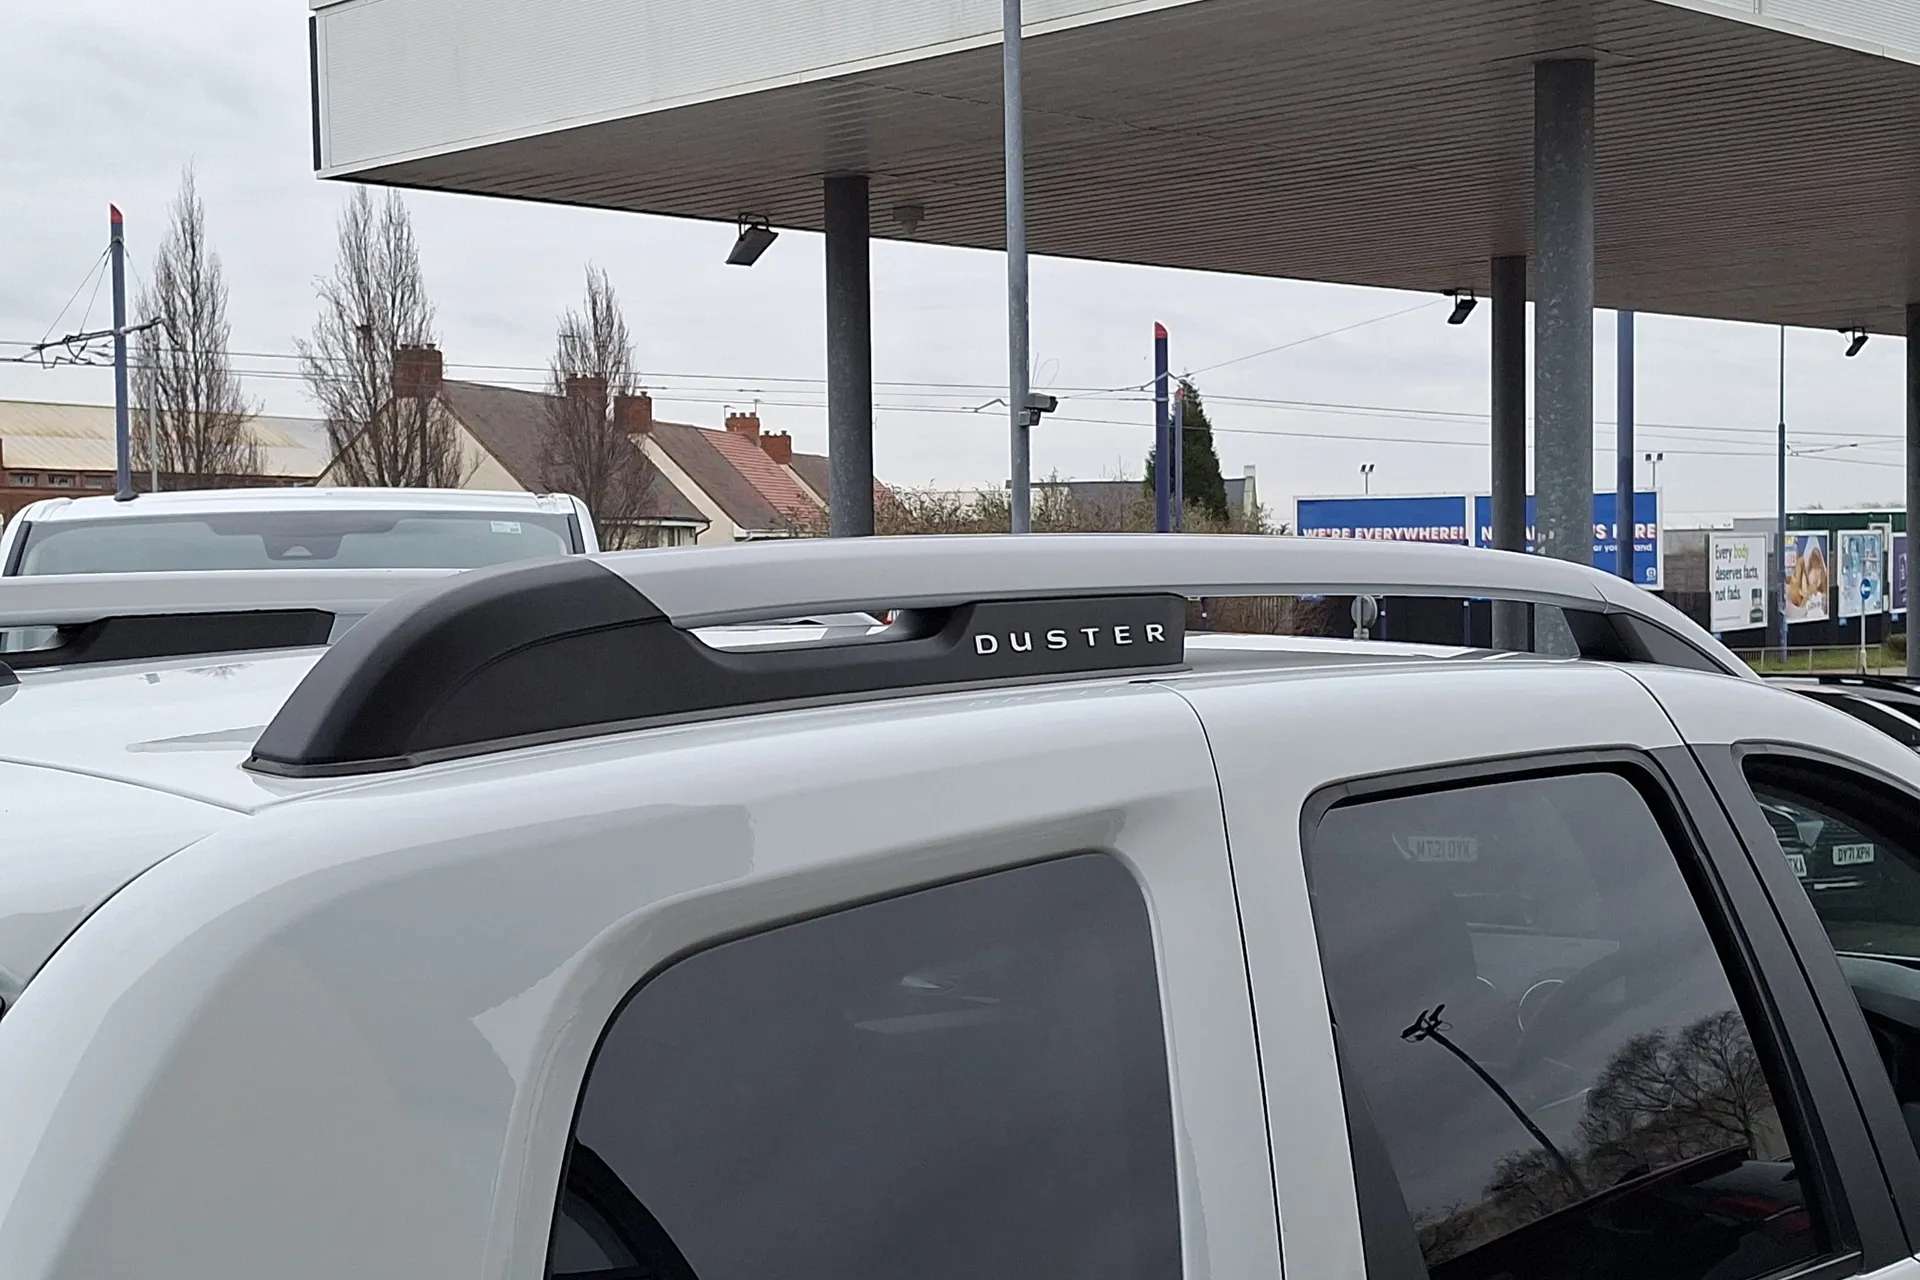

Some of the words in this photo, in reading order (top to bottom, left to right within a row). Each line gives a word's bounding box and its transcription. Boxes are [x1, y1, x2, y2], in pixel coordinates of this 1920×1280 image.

[1303, 527, 1350, 539] WE'RE
[1355, 526, 1464, 540] EVERYWHERE!
[1715, 544, 1732, 563] Every
[1715, 565, 1742, 580] deserves
[1715, 587, 1726, 601] not
[975, 624, 1165, 654] DUSTER
